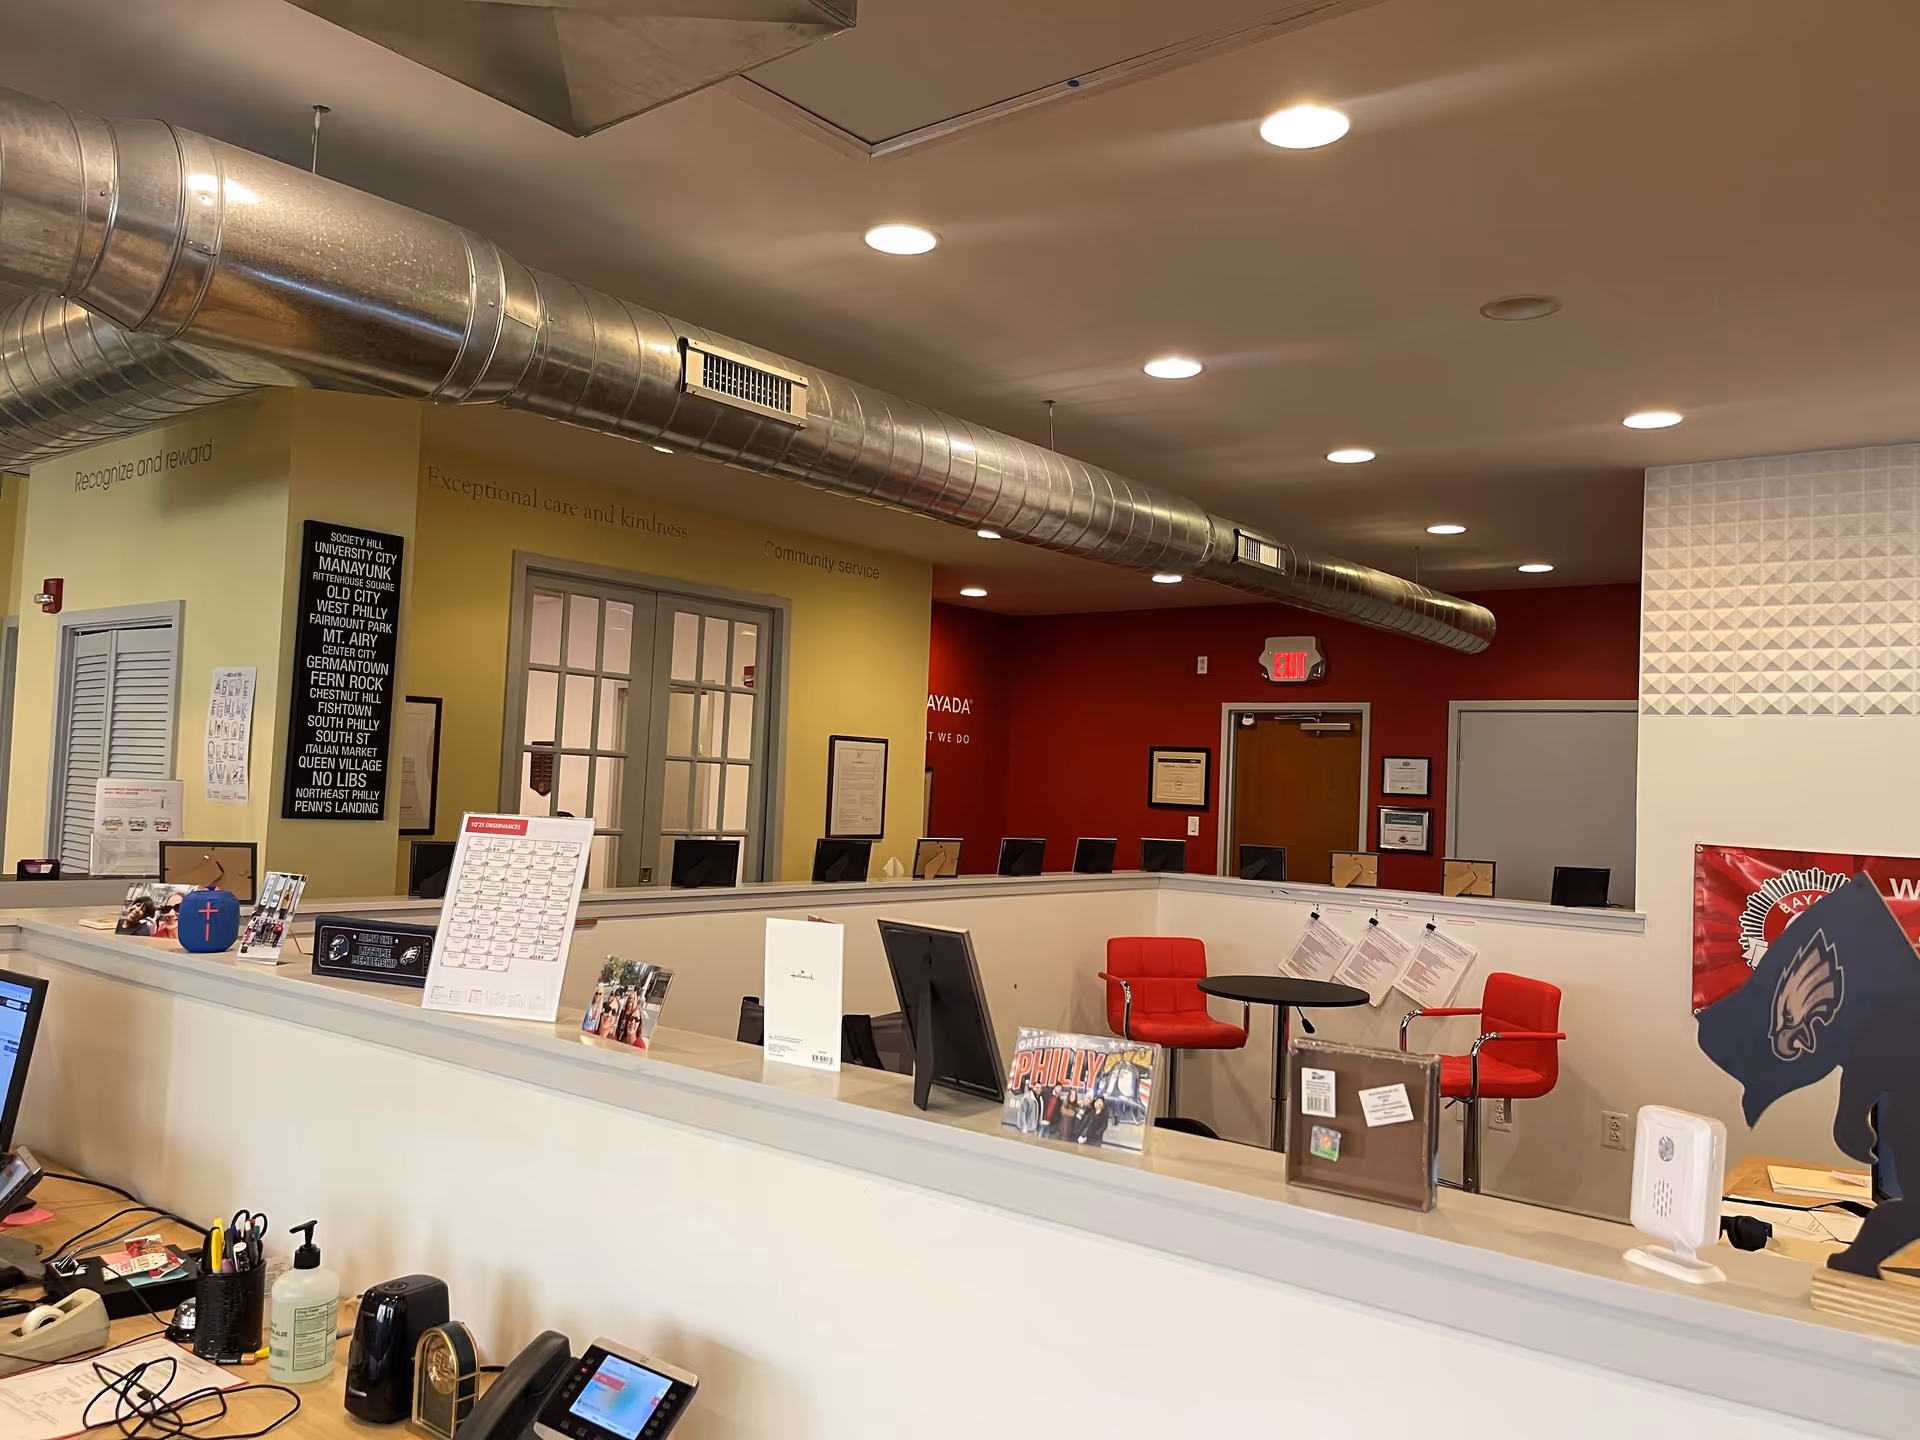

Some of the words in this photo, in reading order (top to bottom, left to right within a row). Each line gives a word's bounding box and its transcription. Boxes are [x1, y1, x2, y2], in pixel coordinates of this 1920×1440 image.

[75, 461, 133, 492] Recognize
[137, 449, 162, 476] and
[166, 438, 212, 470] reward
[428, 465, 537, 508] Exceptional
[544, 498, 579, 515] care
[584, 504, 615, 523] and
[620, 507, 688, 538] kindness
[331, 532, 365, 546] SOCIETY
[367, 539, 383, 549] HILL
[315, 541, 373, 561] UNIVERSITY
[376, 552, 397, 565] CITY
[319, 556, 391, 580] MANAYUNK
[839, 560, 880, 579] service
[313, 572, 364, 587] RITTENHOUSE
[366, 580, 394, 592] SQUARE
[327, 585, 350, 600] OLD
[355, 589, 380, 604] CITY
[317, 599, 349, 615] WEST
[352, 604, 388, 620] PHILLY
[310, 613, 365, 630] FAIRMOUNT
[368, 621, 392, 633] PARK
[323, 628, 345, 644] MT.
[349, 632, 378, 647] AIRY
[322, 645, 355, 657] CENTER
[358, 649, 376, 659] CITY
[306, 655, 389, 675] GERMANTOWN
[1274, 652, 1307, 678] EXIT
[311, 671, 345, 688] FERN
[349, 675, 383, 691] ROCK
[310, 688, 360, 702] CHESTNUT
[362, 692, 381, 703] HILL
[318, 702, 371, 716] FISHTOWN
[308, 715, 343, 728] SOUTH
[347, 718, 380, 731] PHILLY
[316, 730, 353, 743] SOUTH
[356, 733, 370, 744] ST
[938, 732, 952, 743] WE
[956, 733, 970, 745] DO
[305, 744, 339, 755] ITALIAN
[342, 746, 378, 757] MARKET
[299, 756, 335, 769] QUEEN
[339, 758, 382, 771] VILLAGE
[312, 771, 332, 786] NO
[337, 772, 367, 787] LIBS
[296, 788, 350, 799] NORTHEAST
[352, 790, 380, 800] PHILLY
[295, 800, 332, 812] PENN'S
[335, 802, 378, 813] LANDING
[486, 822, 521, 830] OBSERVANCES
[358, 932, 380, 943] ADMIT
[379, 935, 393, 944] ONE
[359, 945, 392, 958] LIFETIME
[351, 954, 397, 969] MEMBERSHIP
[1012, 1047, 1106, 1092] PHILLY
[275, 1330, 288, 1338] ALOE
